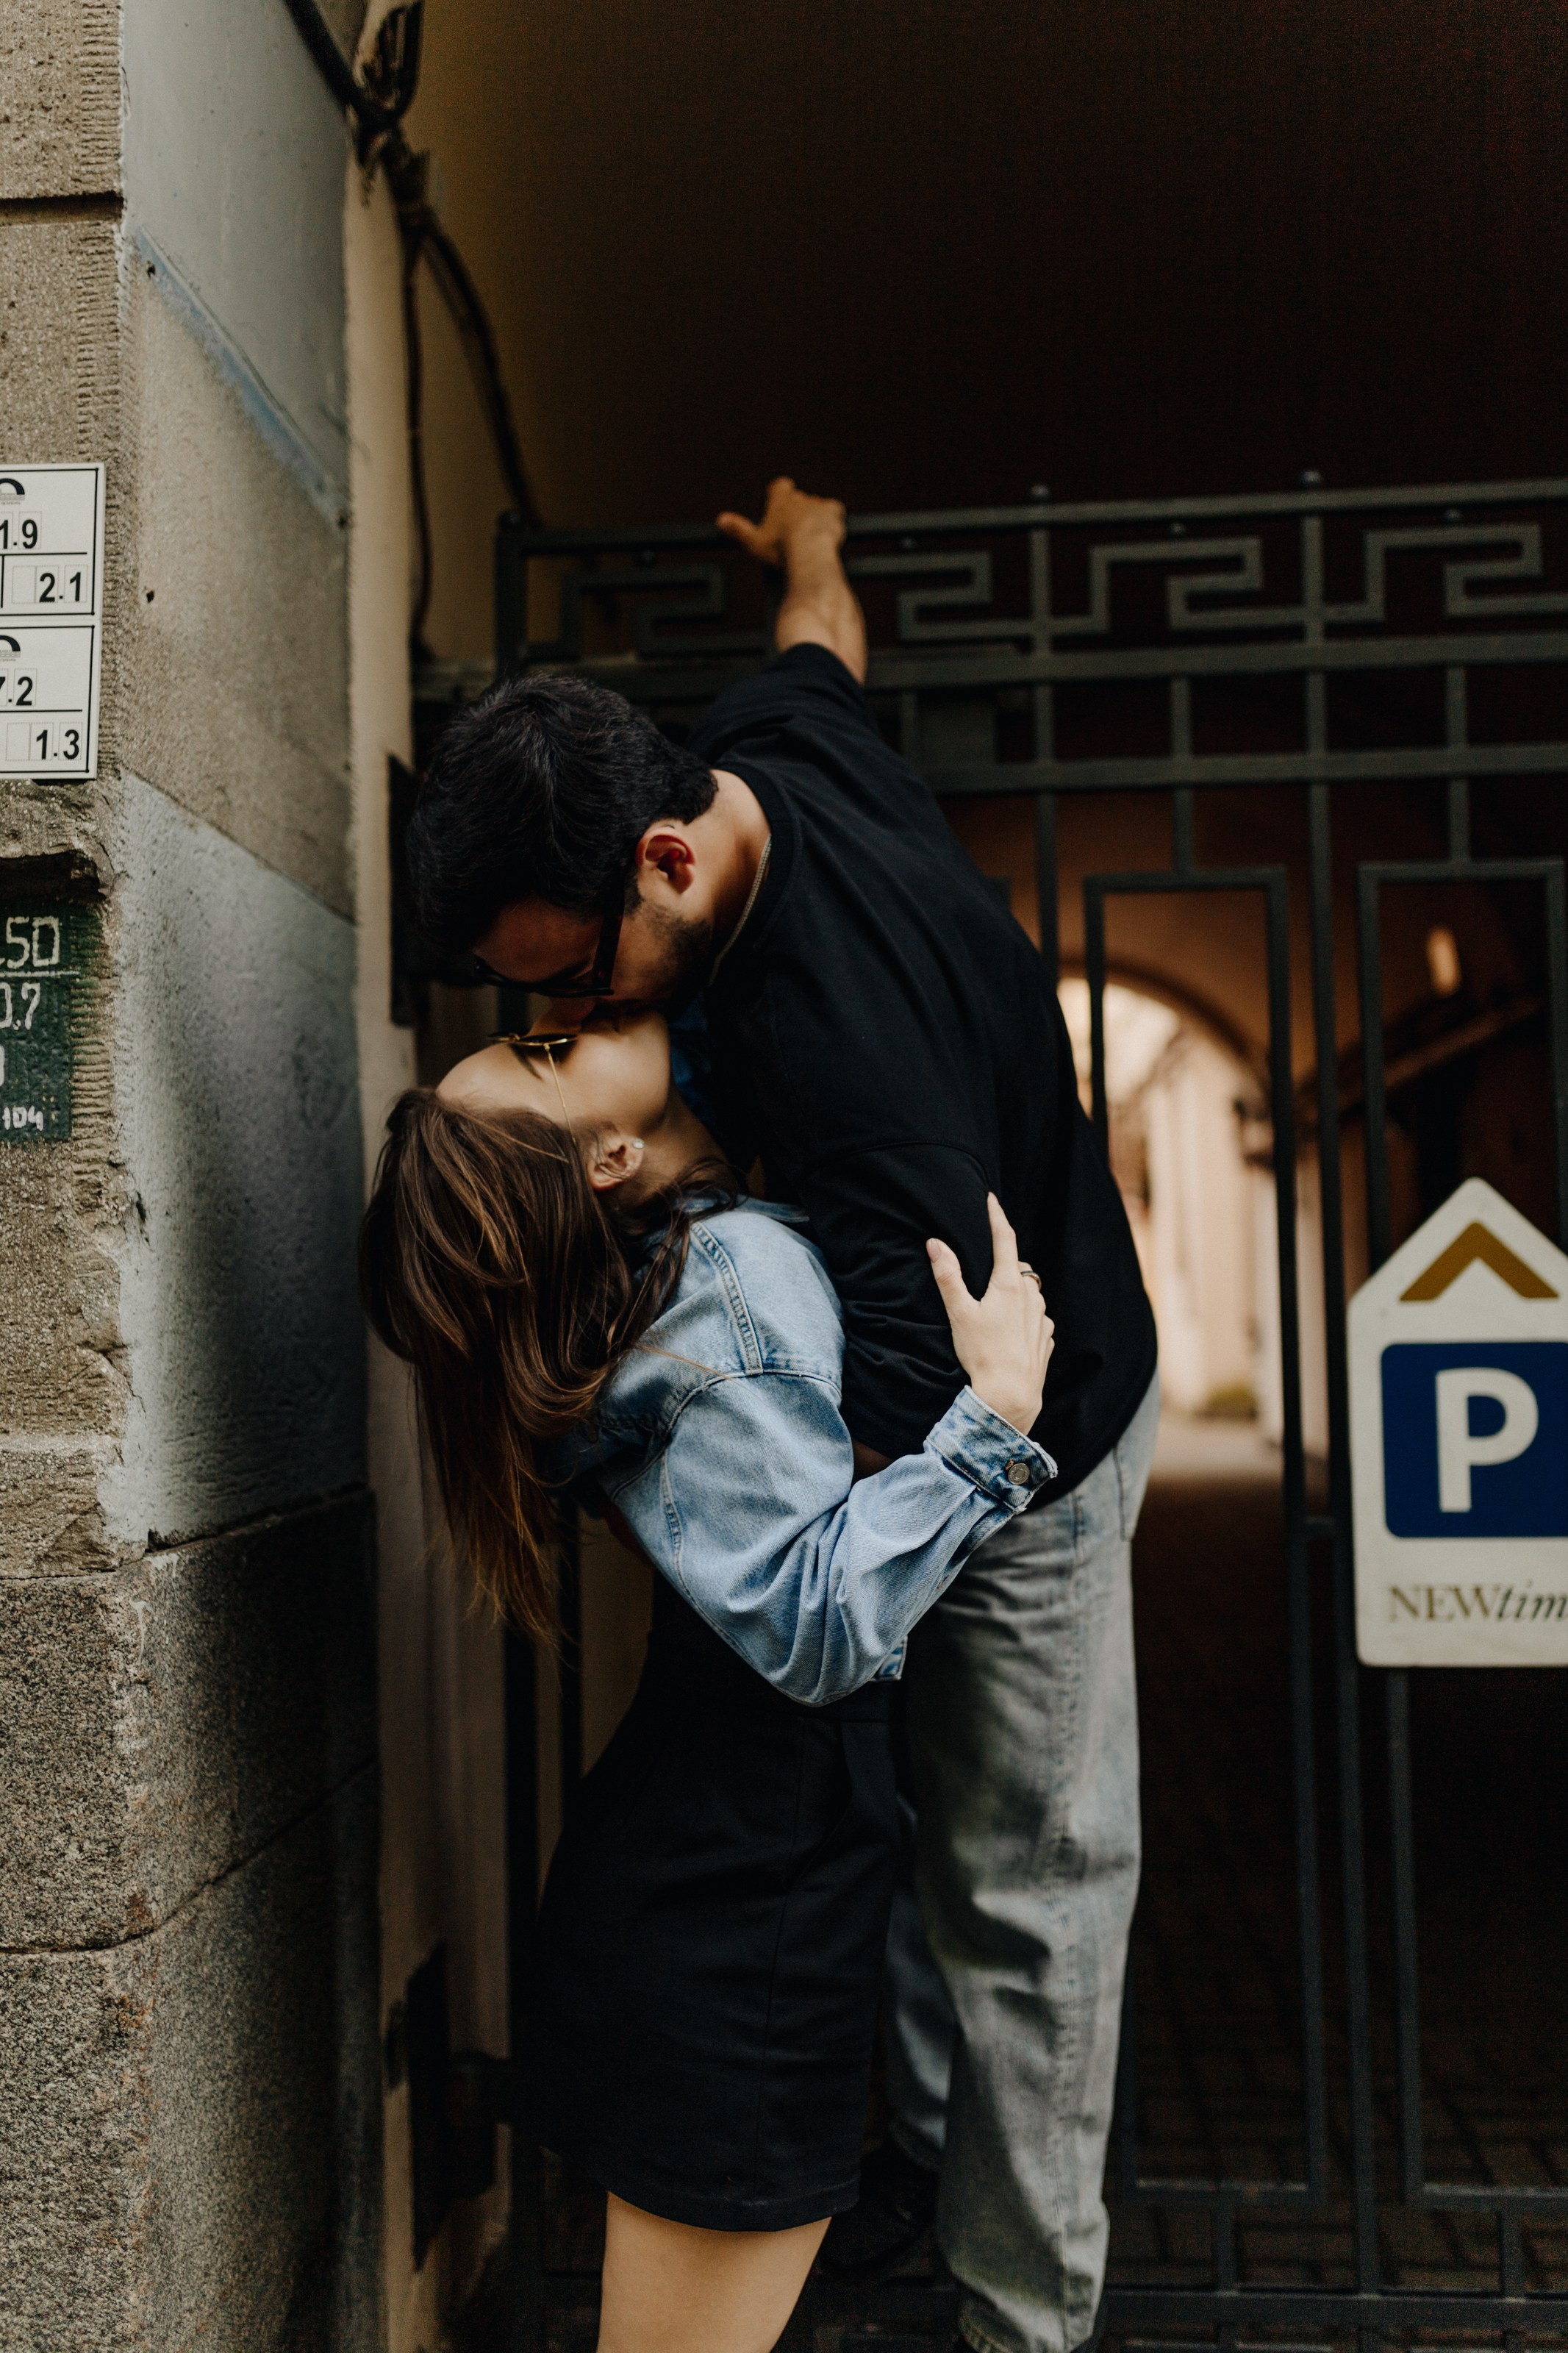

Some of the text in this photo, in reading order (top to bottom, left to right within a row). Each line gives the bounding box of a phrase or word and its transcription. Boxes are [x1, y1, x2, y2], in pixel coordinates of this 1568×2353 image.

[39, 572, 82, 602] 2.1
[36, 729, 79, 760] 1.3
[1436, 1368, 1539, 1513] P
[1389, 1581, 1568, 1621] NEWtim
